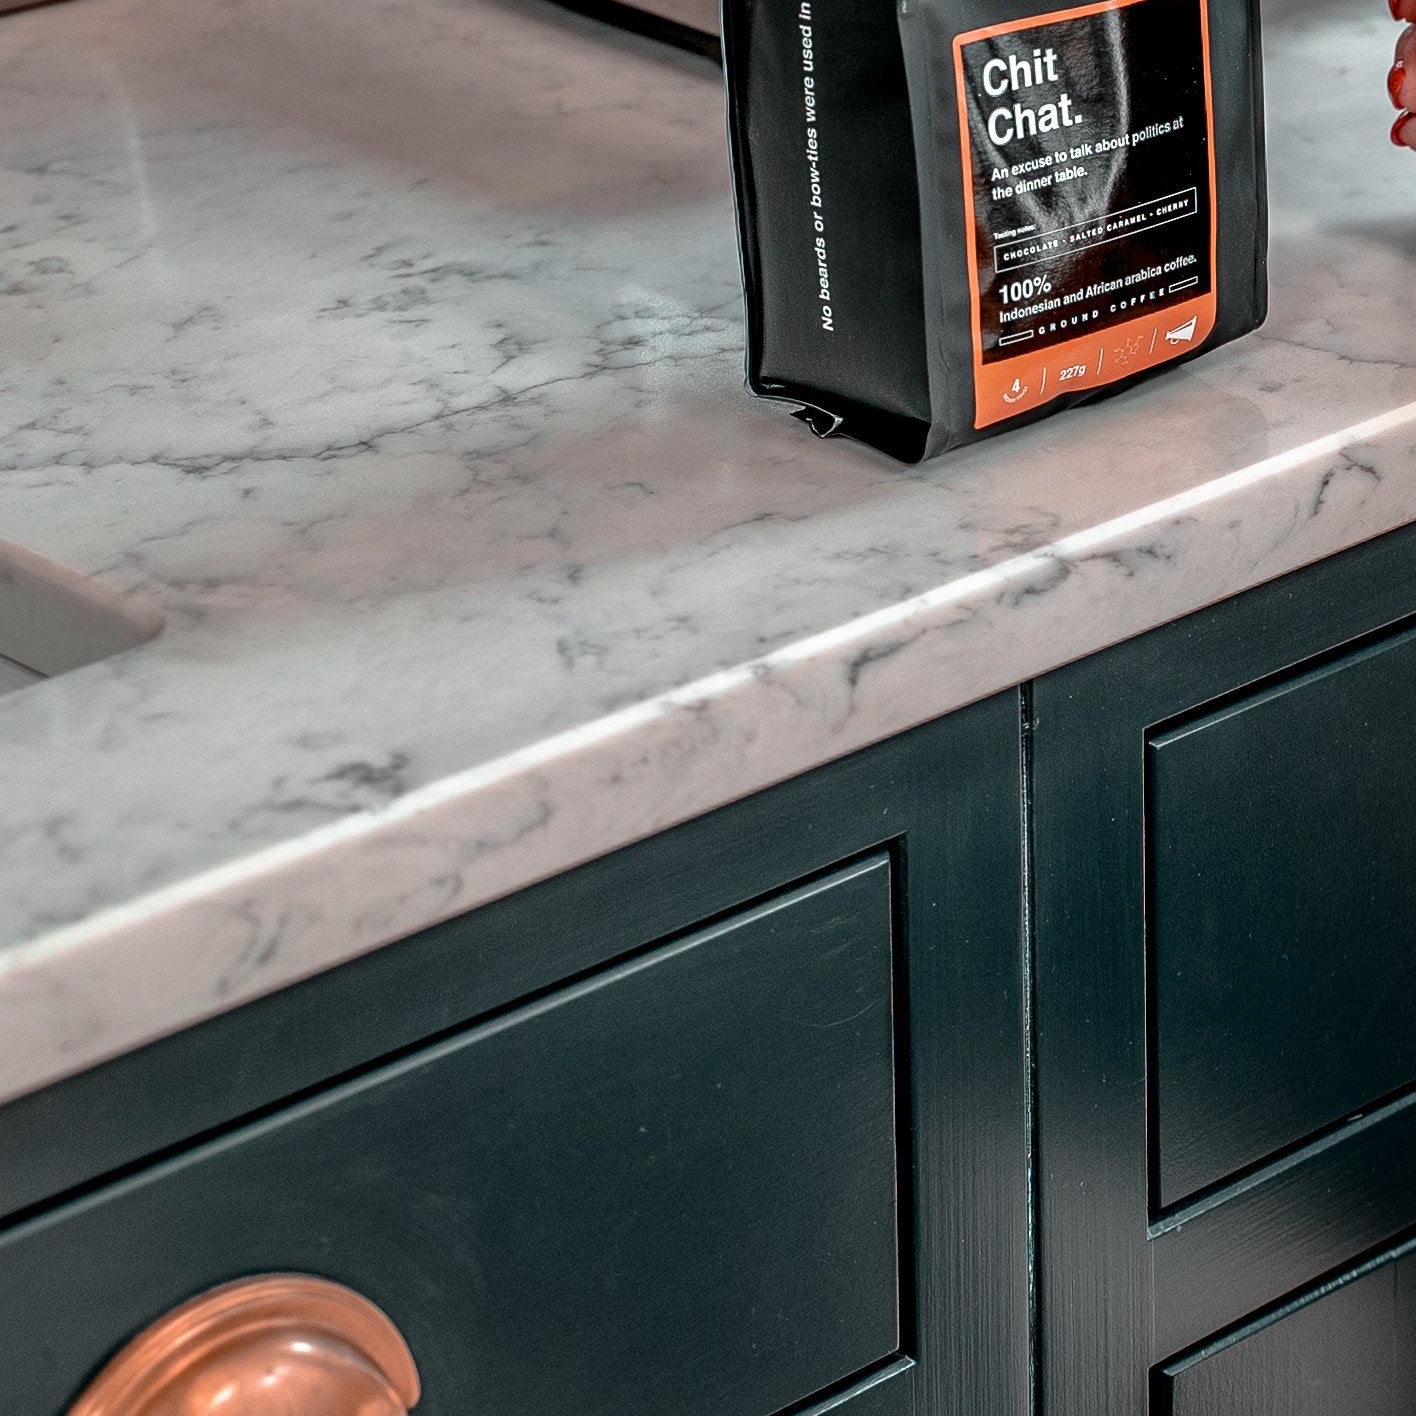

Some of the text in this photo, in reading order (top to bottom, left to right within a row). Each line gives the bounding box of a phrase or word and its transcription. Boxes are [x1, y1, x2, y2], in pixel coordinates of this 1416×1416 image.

[799, 2, 812, 21] in
[800, 24, 814, 72] used
[983, 47, 1059, 97] Chit
[804, 76, 816, 122] were
[987, 93, 1083, 146] Chat.
[807, 127, 822, 208] bow-ties
[991, 115, 1184, 182] An excuse to talk about politics at
[991, 165, 1088, 201] the dinner table.
[812, 213, 824, 232] or
[993, 229, 1016, 240] Tasting
[1003, 199, 1189, 261] CHOCOLATE SALTED CARAMEL CHERRY
[814, 237, 831, 301] beards
[999, 254, 1197, 323] Indonesian and African arabica coffee.
[999, 274, 1052, 304] 100%
[823, 306, 834, 332] No
[1039, 287, 1165, 335] GROUND COFFEE
[1012, 378, 1020, 392] 4
[1058, 365, 1086, 382] 227g
